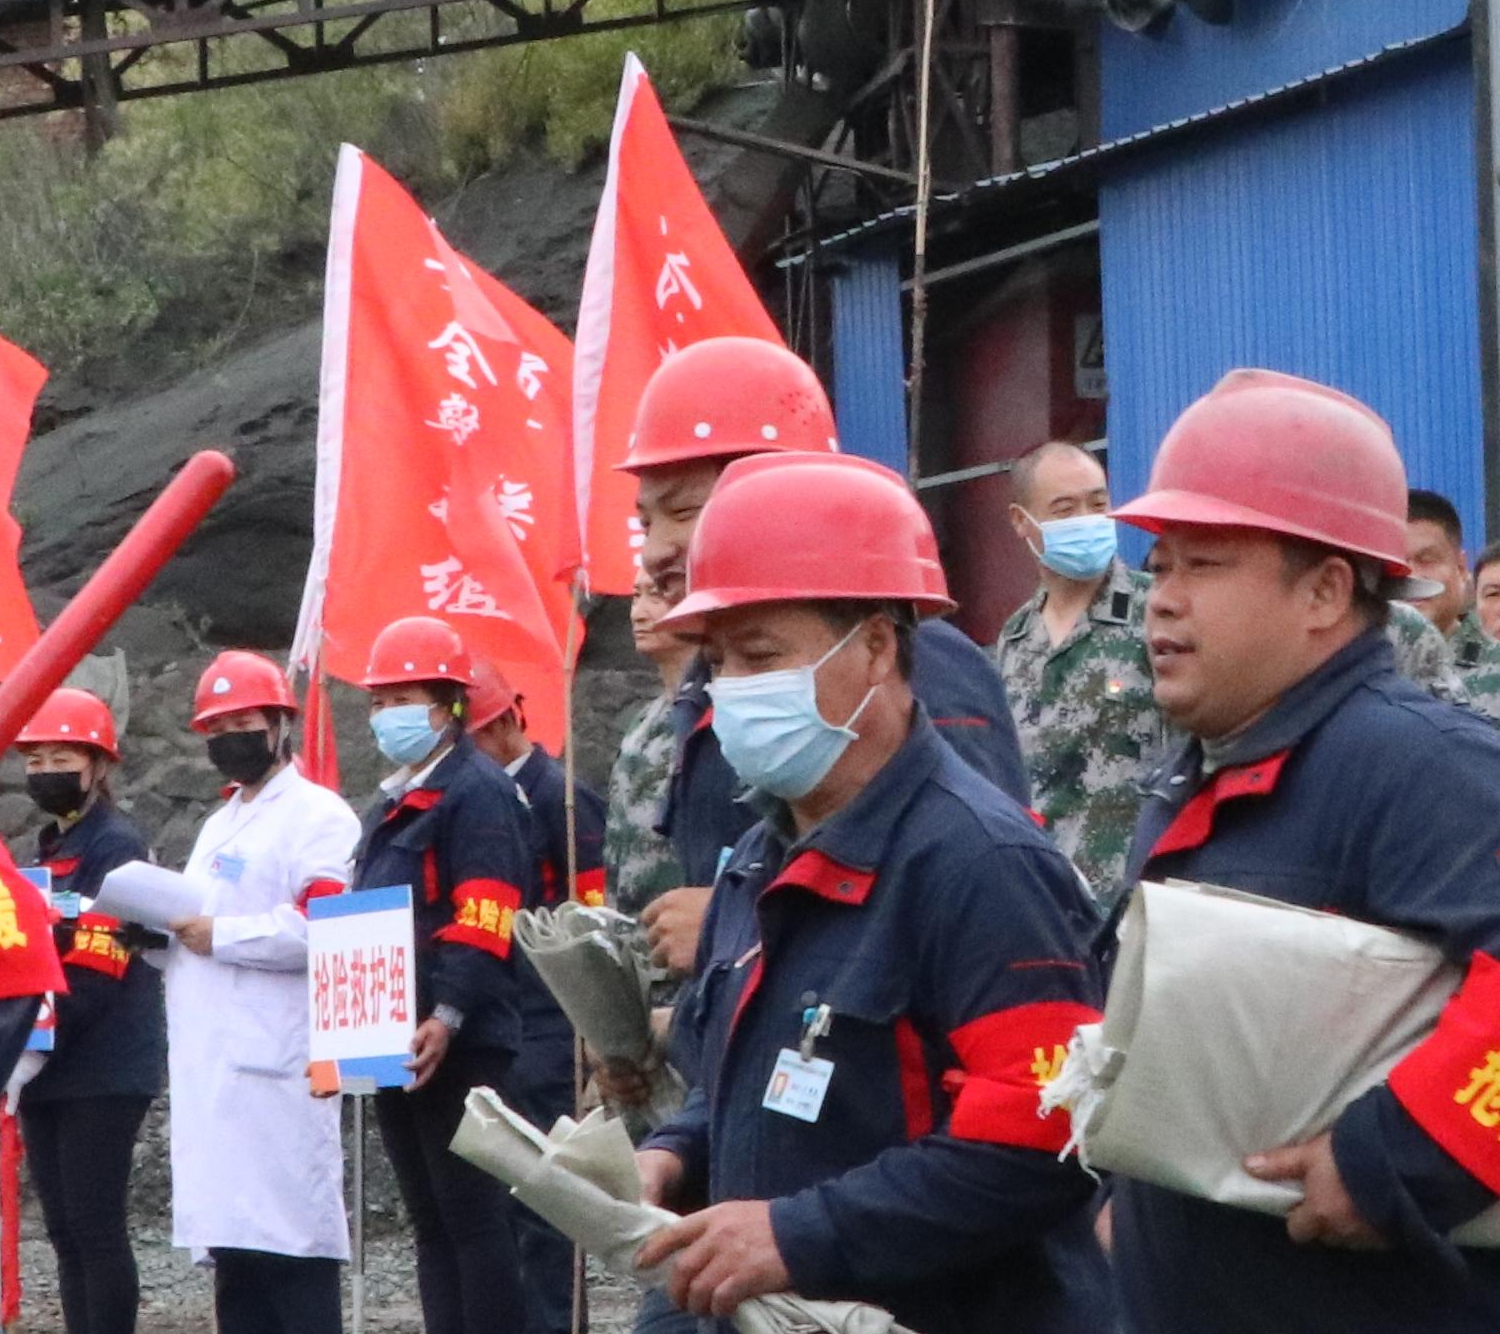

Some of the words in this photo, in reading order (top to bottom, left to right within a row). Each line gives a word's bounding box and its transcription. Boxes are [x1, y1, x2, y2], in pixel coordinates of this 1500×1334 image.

[314, 946, 408, 1031] 抢险救护组
